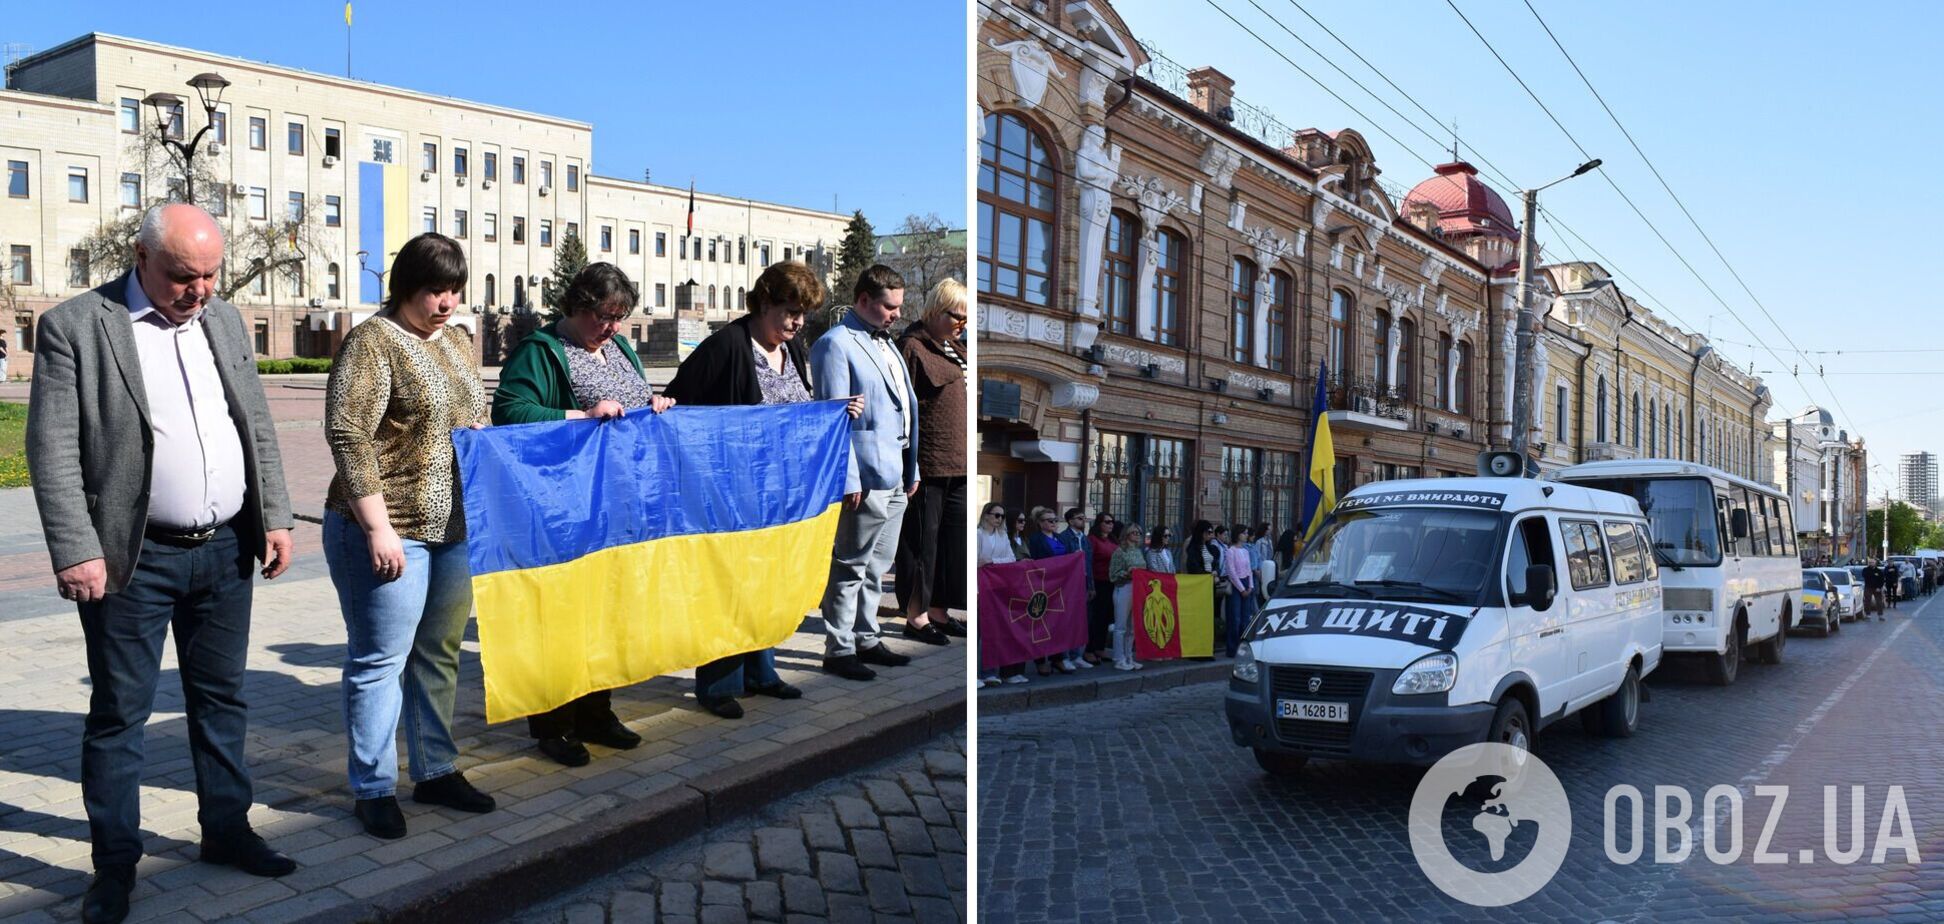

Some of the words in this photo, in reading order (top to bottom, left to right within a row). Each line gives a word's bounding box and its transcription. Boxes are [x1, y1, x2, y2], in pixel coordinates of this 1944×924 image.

[1406, 493, 1501, 506] ВМИРАЮТЬ
[1284, 703, 1299, 716] BA
[1302, 704, 1326, 718] 1628
